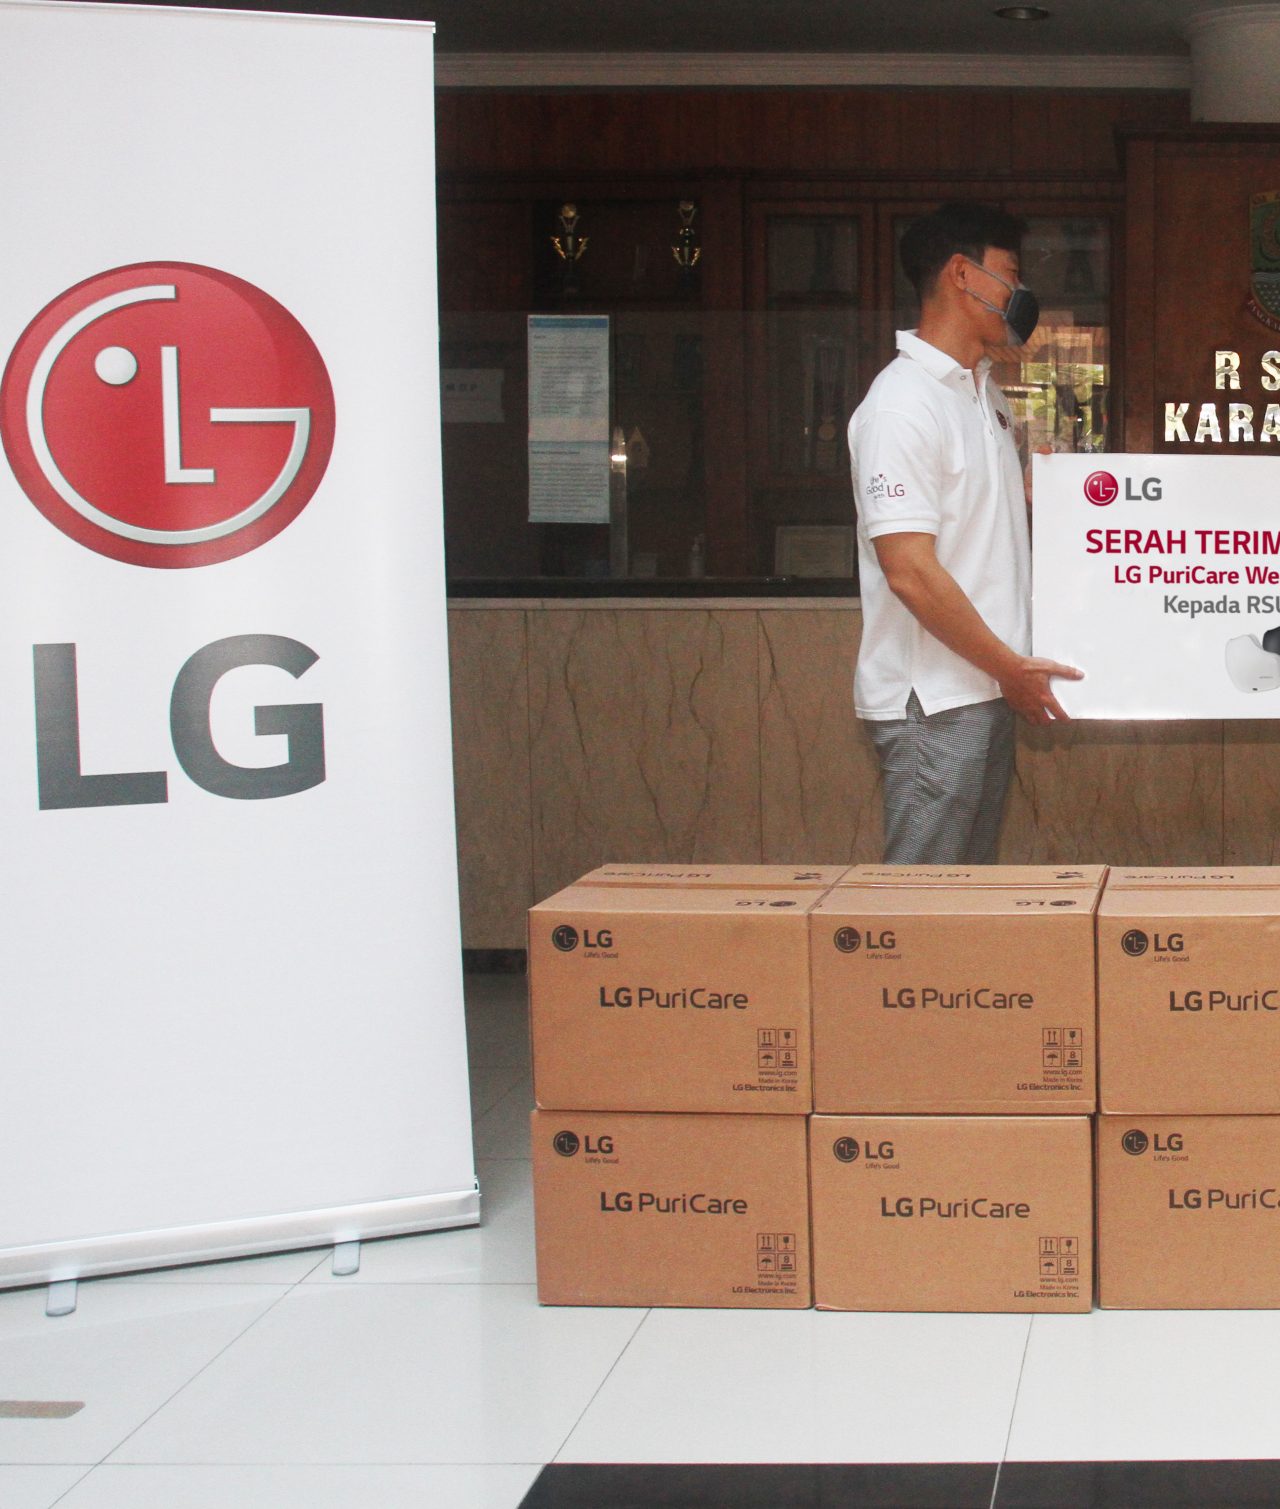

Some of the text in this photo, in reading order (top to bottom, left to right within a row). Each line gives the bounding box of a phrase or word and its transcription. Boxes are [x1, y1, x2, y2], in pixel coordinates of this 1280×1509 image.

[887, 484, 905, 497] LG
[1126, 478, 1162, 501] LG
[1086, 529, 1186, 554] SERAH
[1115, 565, 1141, 584] LG
[1149, 566, 1239, 584] PuriCare
[1165, 595, 1240, 618] Kepada
[32, 633, 327, 811] LG
[584, 930, 613, 947] LG
[866, 931, 896, 949] LG
[1154, 934, 1184, 952] LG
[600, 987, 749, 1009] LG PuriCare
[882, 988, 1034, 1009] LG PuriCare
[1170, 990, 1202, 1012] LG
[585, 1136, 613, 1154] LG
[865, 1141, 894, 1159] LG
[1154, 1133, 1183, 1151] LG
[600, 1192, 748, 1214] LG PuriCare
[881, 1197, 1030, 1219] LG PuriCare
[1170, 1189, 1202, 1209] LG
